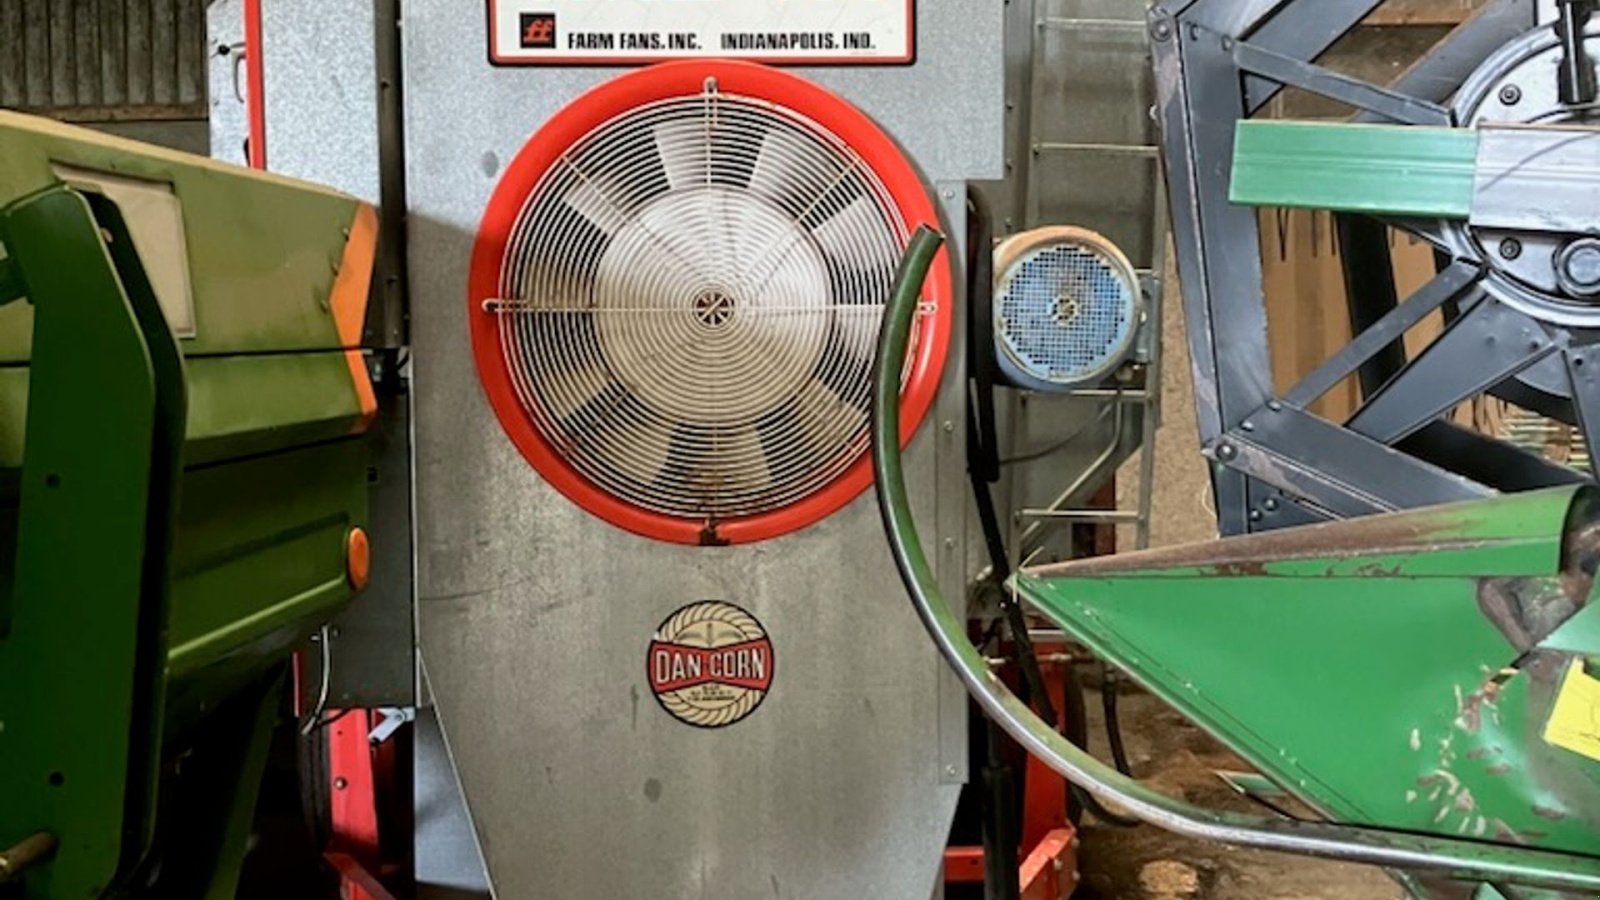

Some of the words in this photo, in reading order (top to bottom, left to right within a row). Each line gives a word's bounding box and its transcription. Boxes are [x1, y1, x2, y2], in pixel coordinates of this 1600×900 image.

[568, 33, 614, 49] FARM
[668, 33, 702, 49] INC.
[843, 33, 876, 49] IND.
